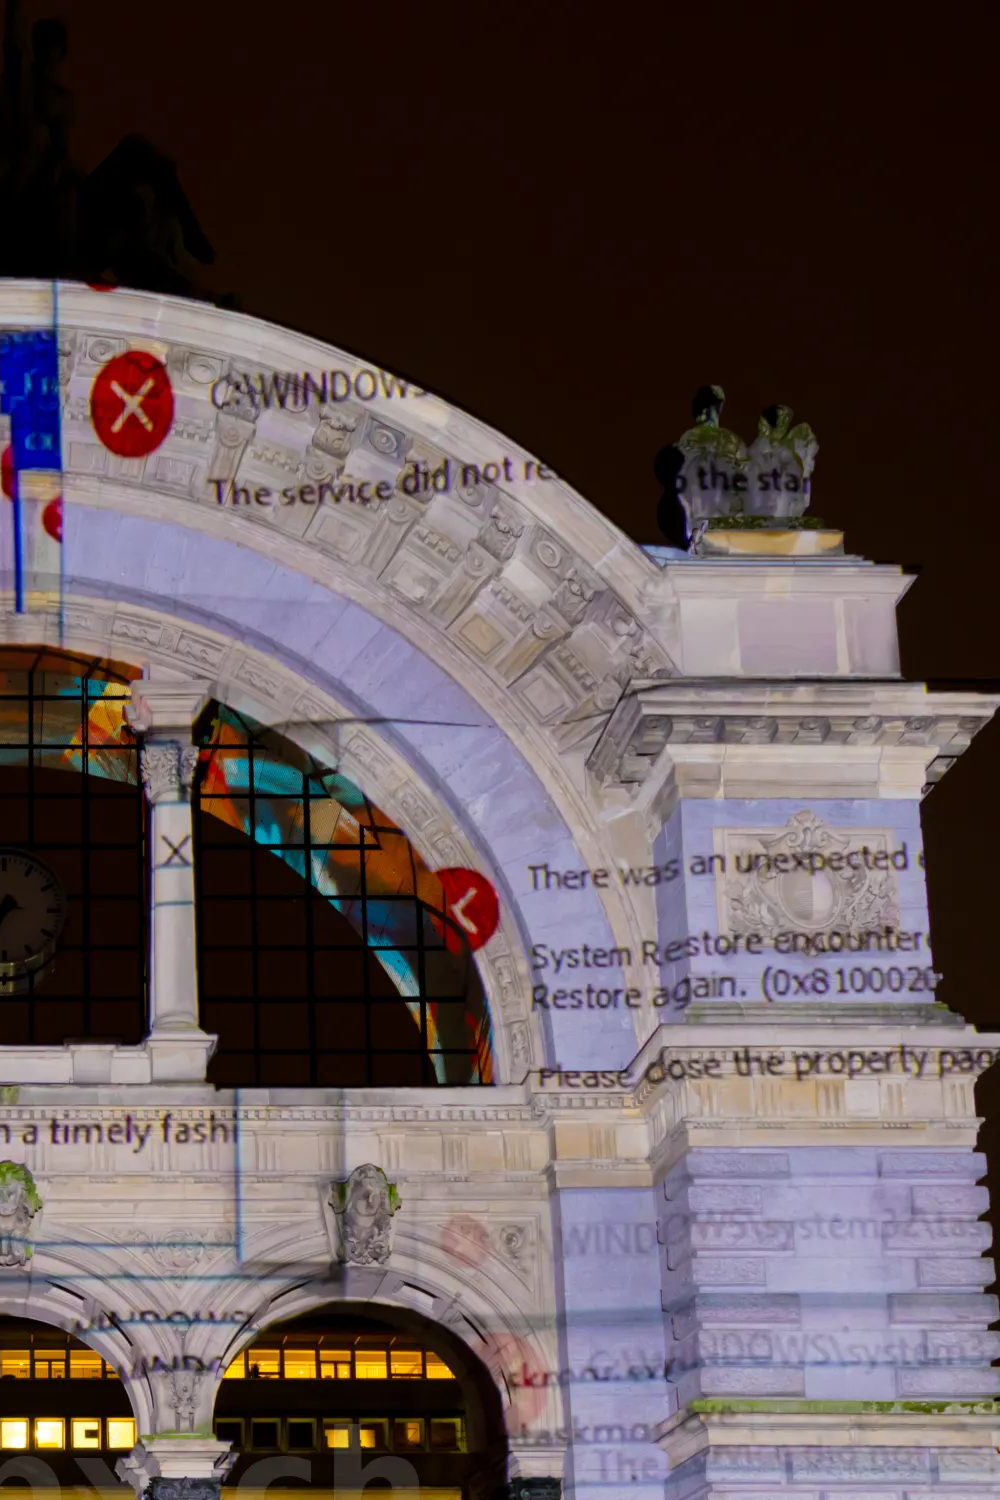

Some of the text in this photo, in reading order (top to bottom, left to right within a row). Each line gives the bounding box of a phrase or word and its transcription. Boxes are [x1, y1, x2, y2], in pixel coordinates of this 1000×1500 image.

[209, 478, 273, 506] The
[278, 478, 393, 506] service
[402, 459, 451, 496] did
[462, 457, 514, 487] not
[700, 467, 748, 491] the
[528, 862, 610, 895] There
[619, 858, 681, 889] was
[690, 852, 727, 877] an
[734, 841, 909, 877] unexpected
[531, 941, 632, 974] System
[641, 928, 763, 970] Restore
[531, 982, 642, 1014] Restore
[652, 969, 748, 1014] again.
[538, 1064, 636, 1092] Please
[644, 1050, 722, 1082] close
[733, 1046, 786, 1078] the
[794, 1044, 927, 1081] property
[20, 1122, 40, 1145] a
[47, 1114, 152, 1153] timely
[599, 1449, 659, 1483] The
